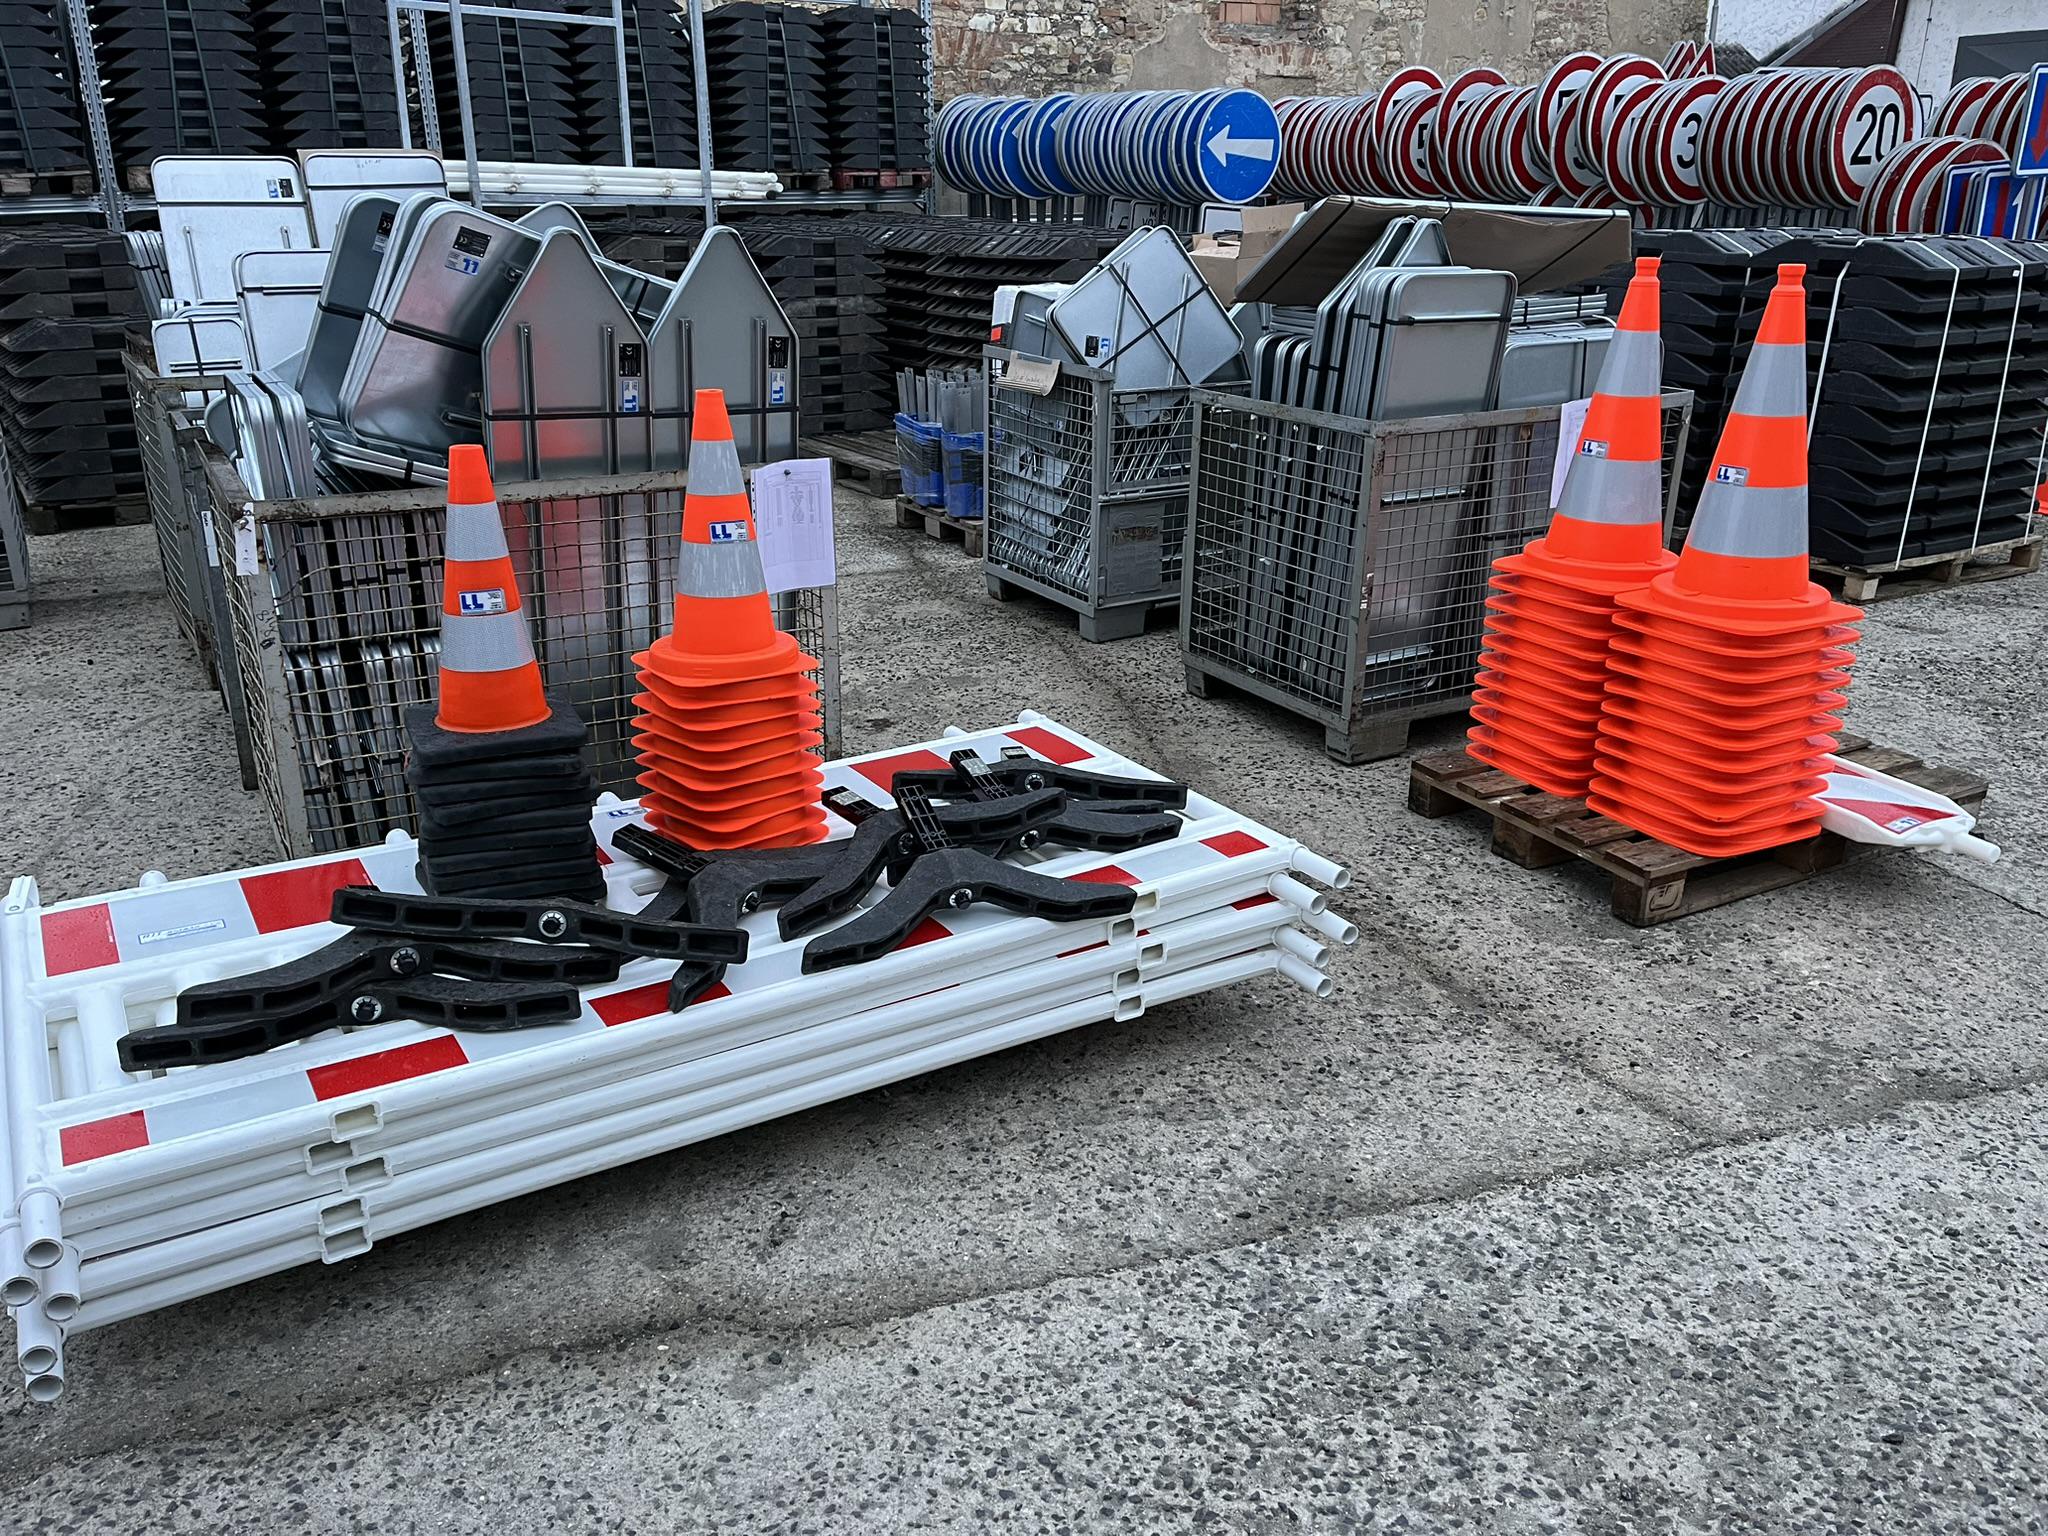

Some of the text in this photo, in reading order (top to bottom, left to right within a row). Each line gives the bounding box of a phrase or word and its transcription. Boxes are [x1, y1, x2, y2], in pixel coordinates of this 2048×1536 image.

[1849, 103, 1900, 166] 20
[1717, 467, 1730, 480] LL
[711, 524, 732, 540] LL
[460, 594, 484, 610] LL
